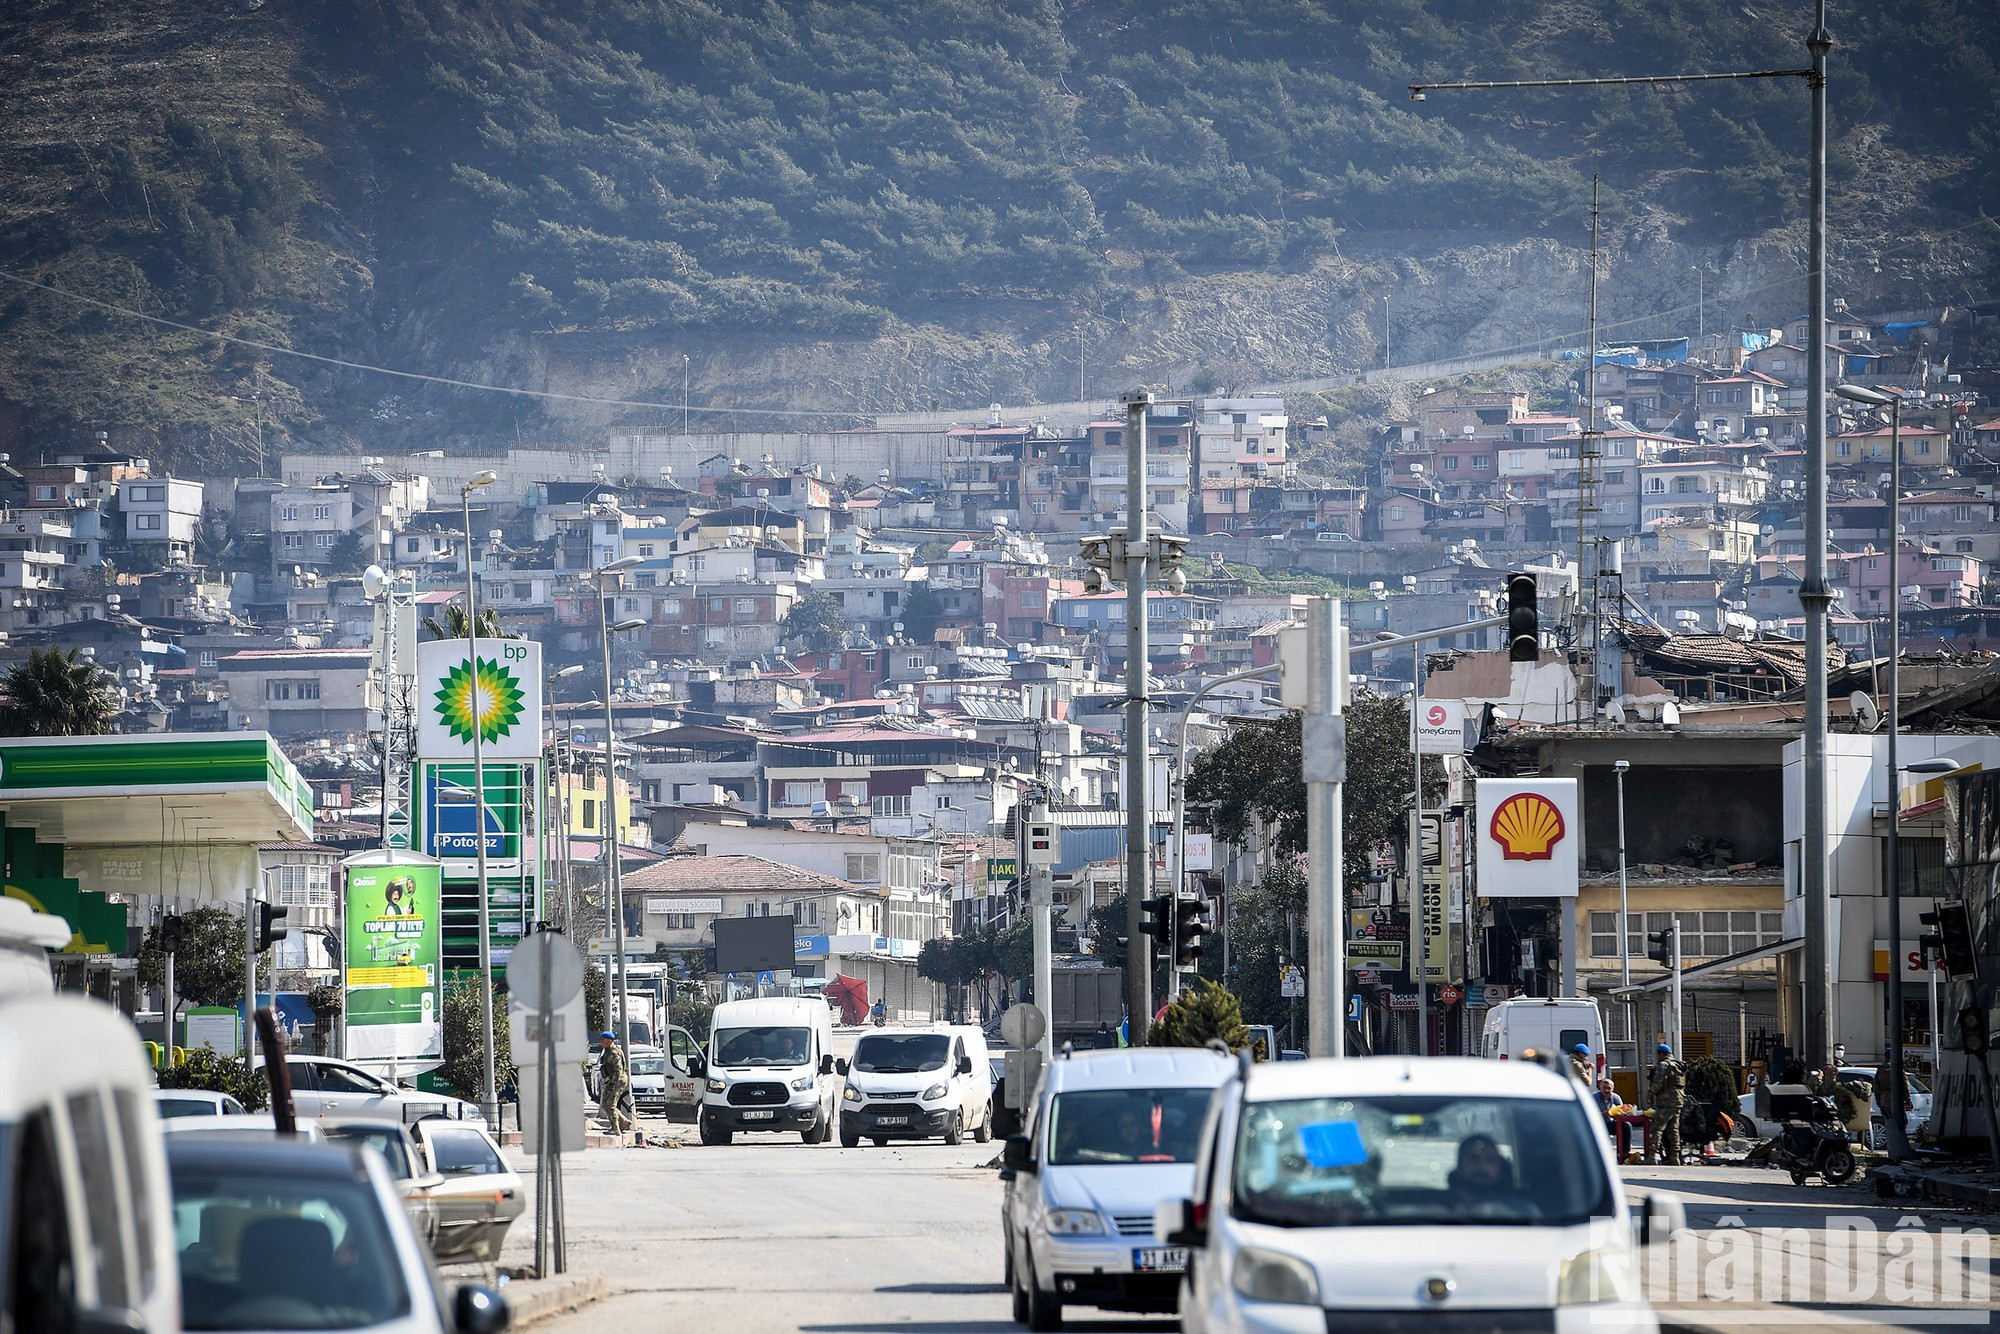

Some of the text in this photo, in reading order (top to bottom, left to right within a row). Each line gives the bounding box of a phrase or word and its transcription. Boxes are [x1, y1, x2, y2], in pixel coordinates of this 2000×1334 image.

[504, 643, 527, 662] bp
[1413, 727, 1461, 736] oneyGram
[690, 900, 720, 908] SİGORTA
[1431, 884, 1441, 936] UNION
[365, 921, 396, 933] TOPLAM
[1442, 988, 1457, 998] ria
